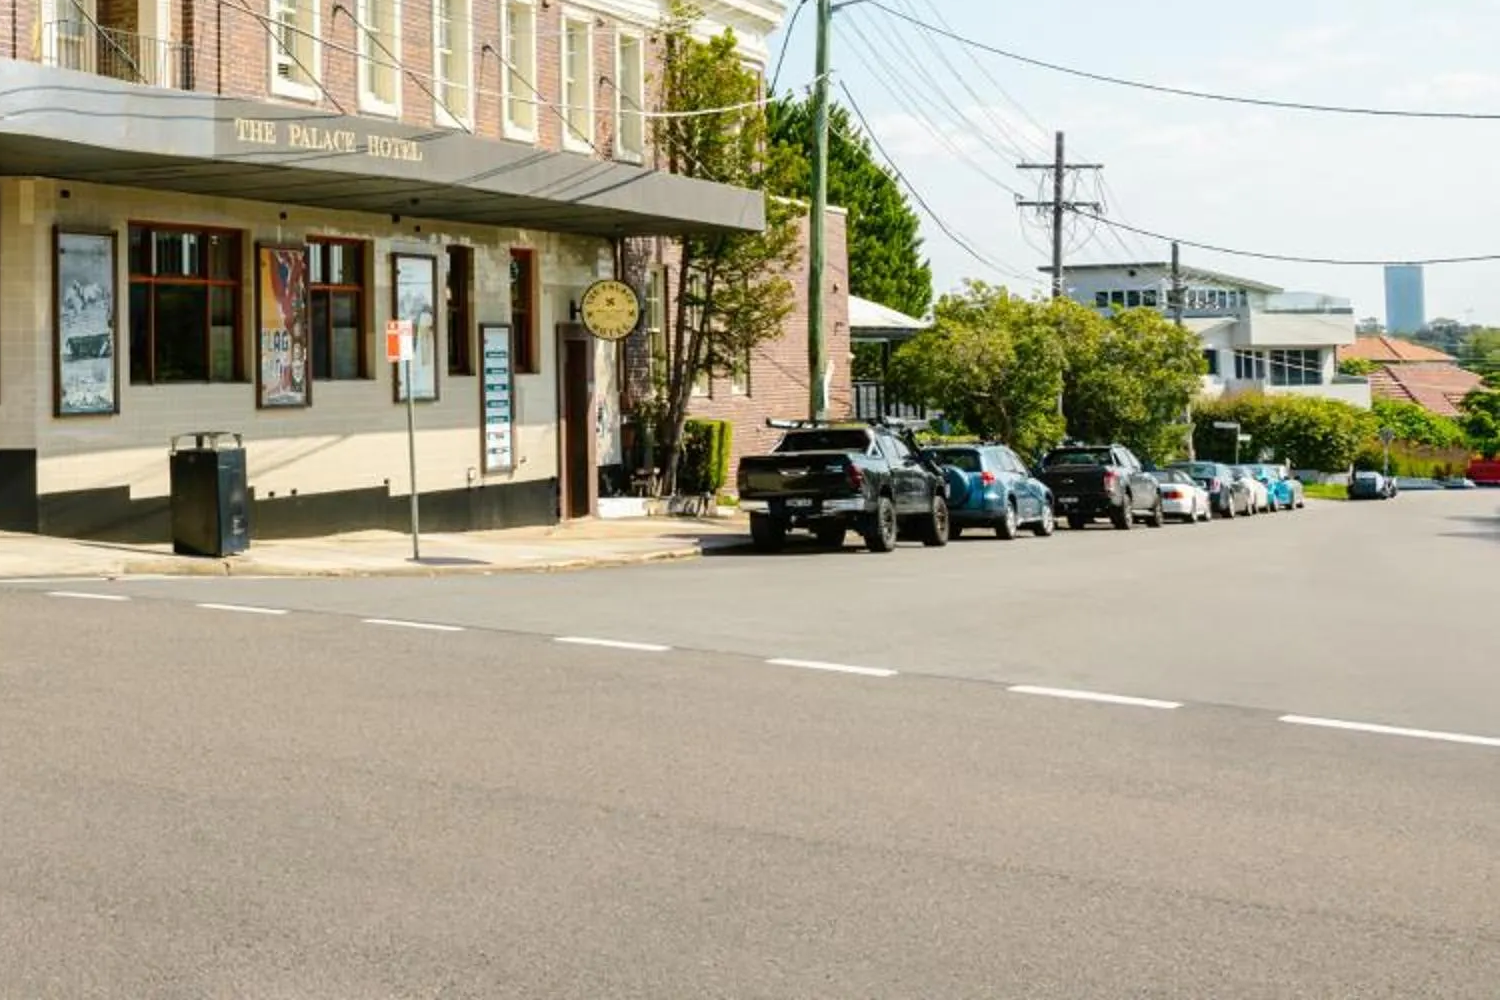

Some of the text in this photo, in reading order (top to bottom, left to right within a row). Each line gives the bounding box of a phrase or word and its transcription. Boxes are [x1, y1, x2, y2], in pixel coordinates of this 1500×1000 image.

[234, 117, 423, 161] THE PALACE HOTEL
